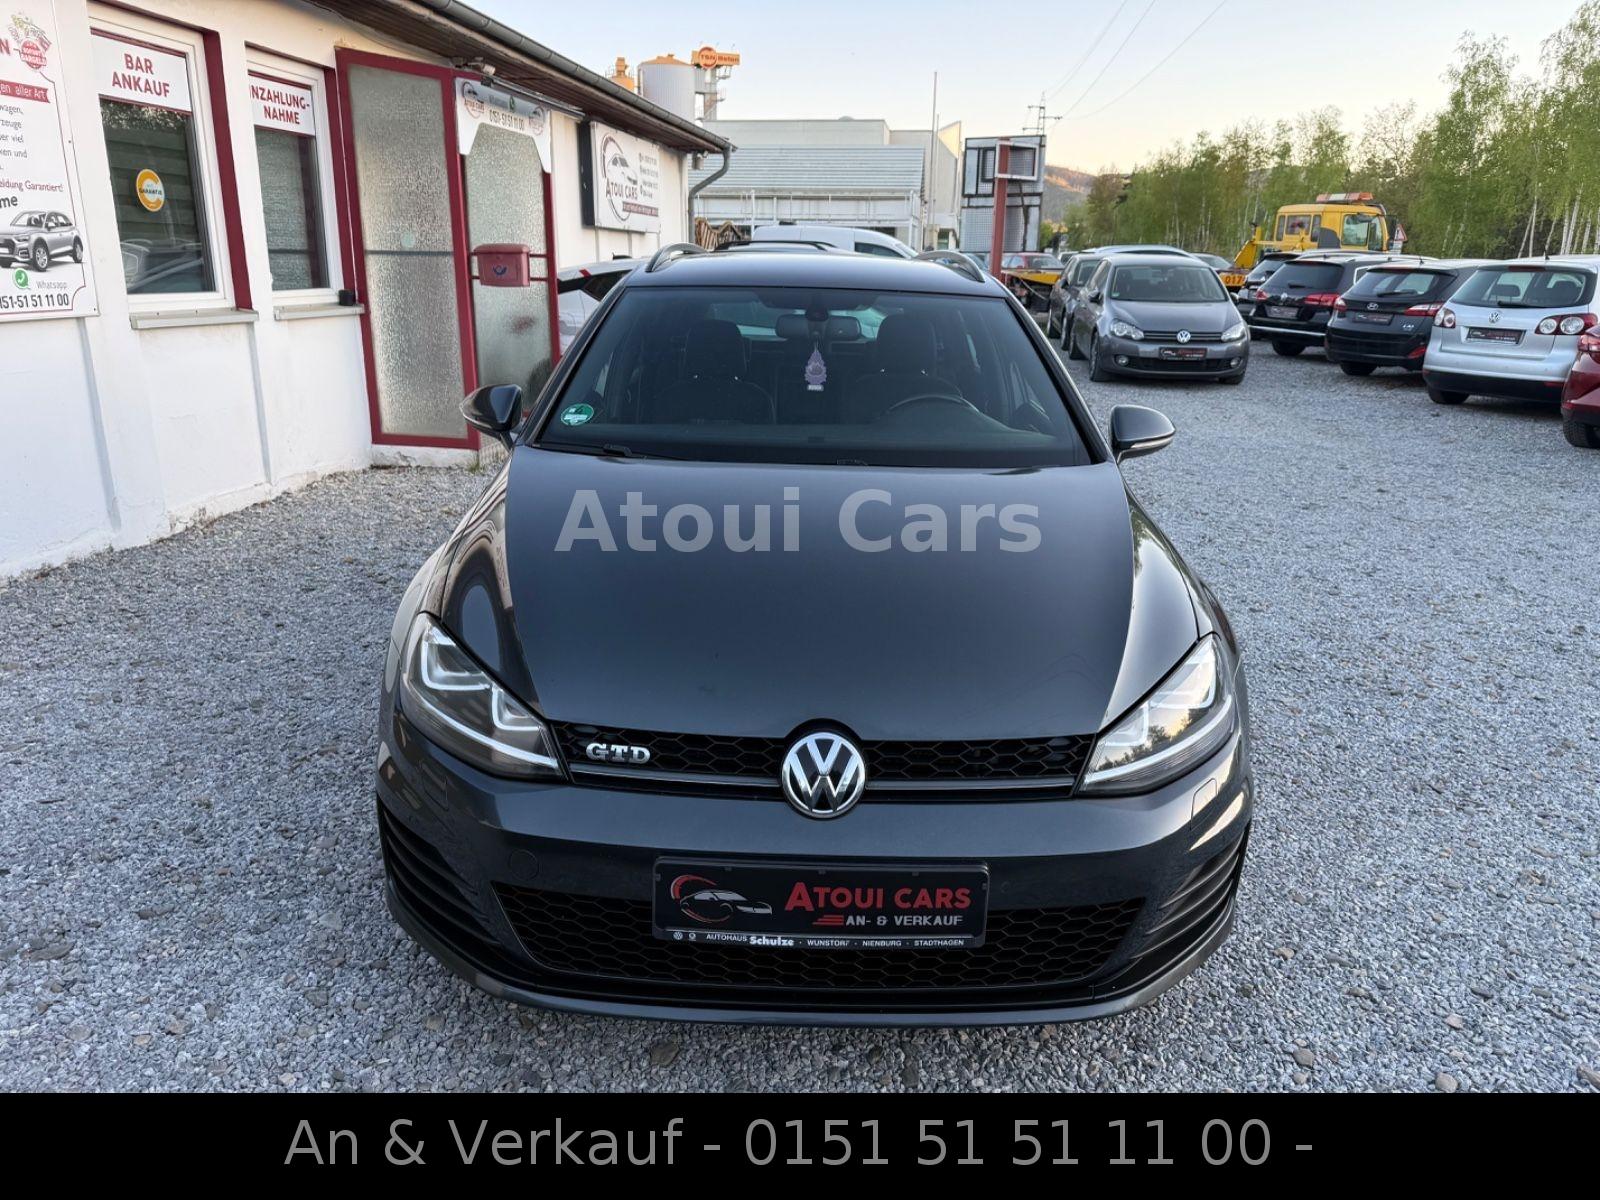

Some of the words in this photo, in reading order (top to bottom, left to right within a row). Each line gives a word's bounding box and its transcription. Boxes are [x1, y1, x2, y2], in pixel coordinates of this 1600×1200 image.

[124, 53, 154, 75] BAR
[112, 71, 170, 97] ANKAUF
[250, 84, 310, 110] NZAHLUNG-
[264, 105, 300, 125] NAHME
[31, 293, 43, 308] 51
[45, 293, 55, 307] 11
[57, 292, 69, 306] 00
[586, 742, 651, 765] GTD
[784, 881, 884, 912] ATOUI
[894, 887, 972, 910] CARS
[846, 915, 871, 926] AN-
[877, 915, 889, 926] &
[894, 915, 963, 926] VERKAUF
[706, 933, 747, 942] AUTOHAUS
[749, 935, 795, 947] Schulze
[914, 939, 965, 947] STADTHAGEN
